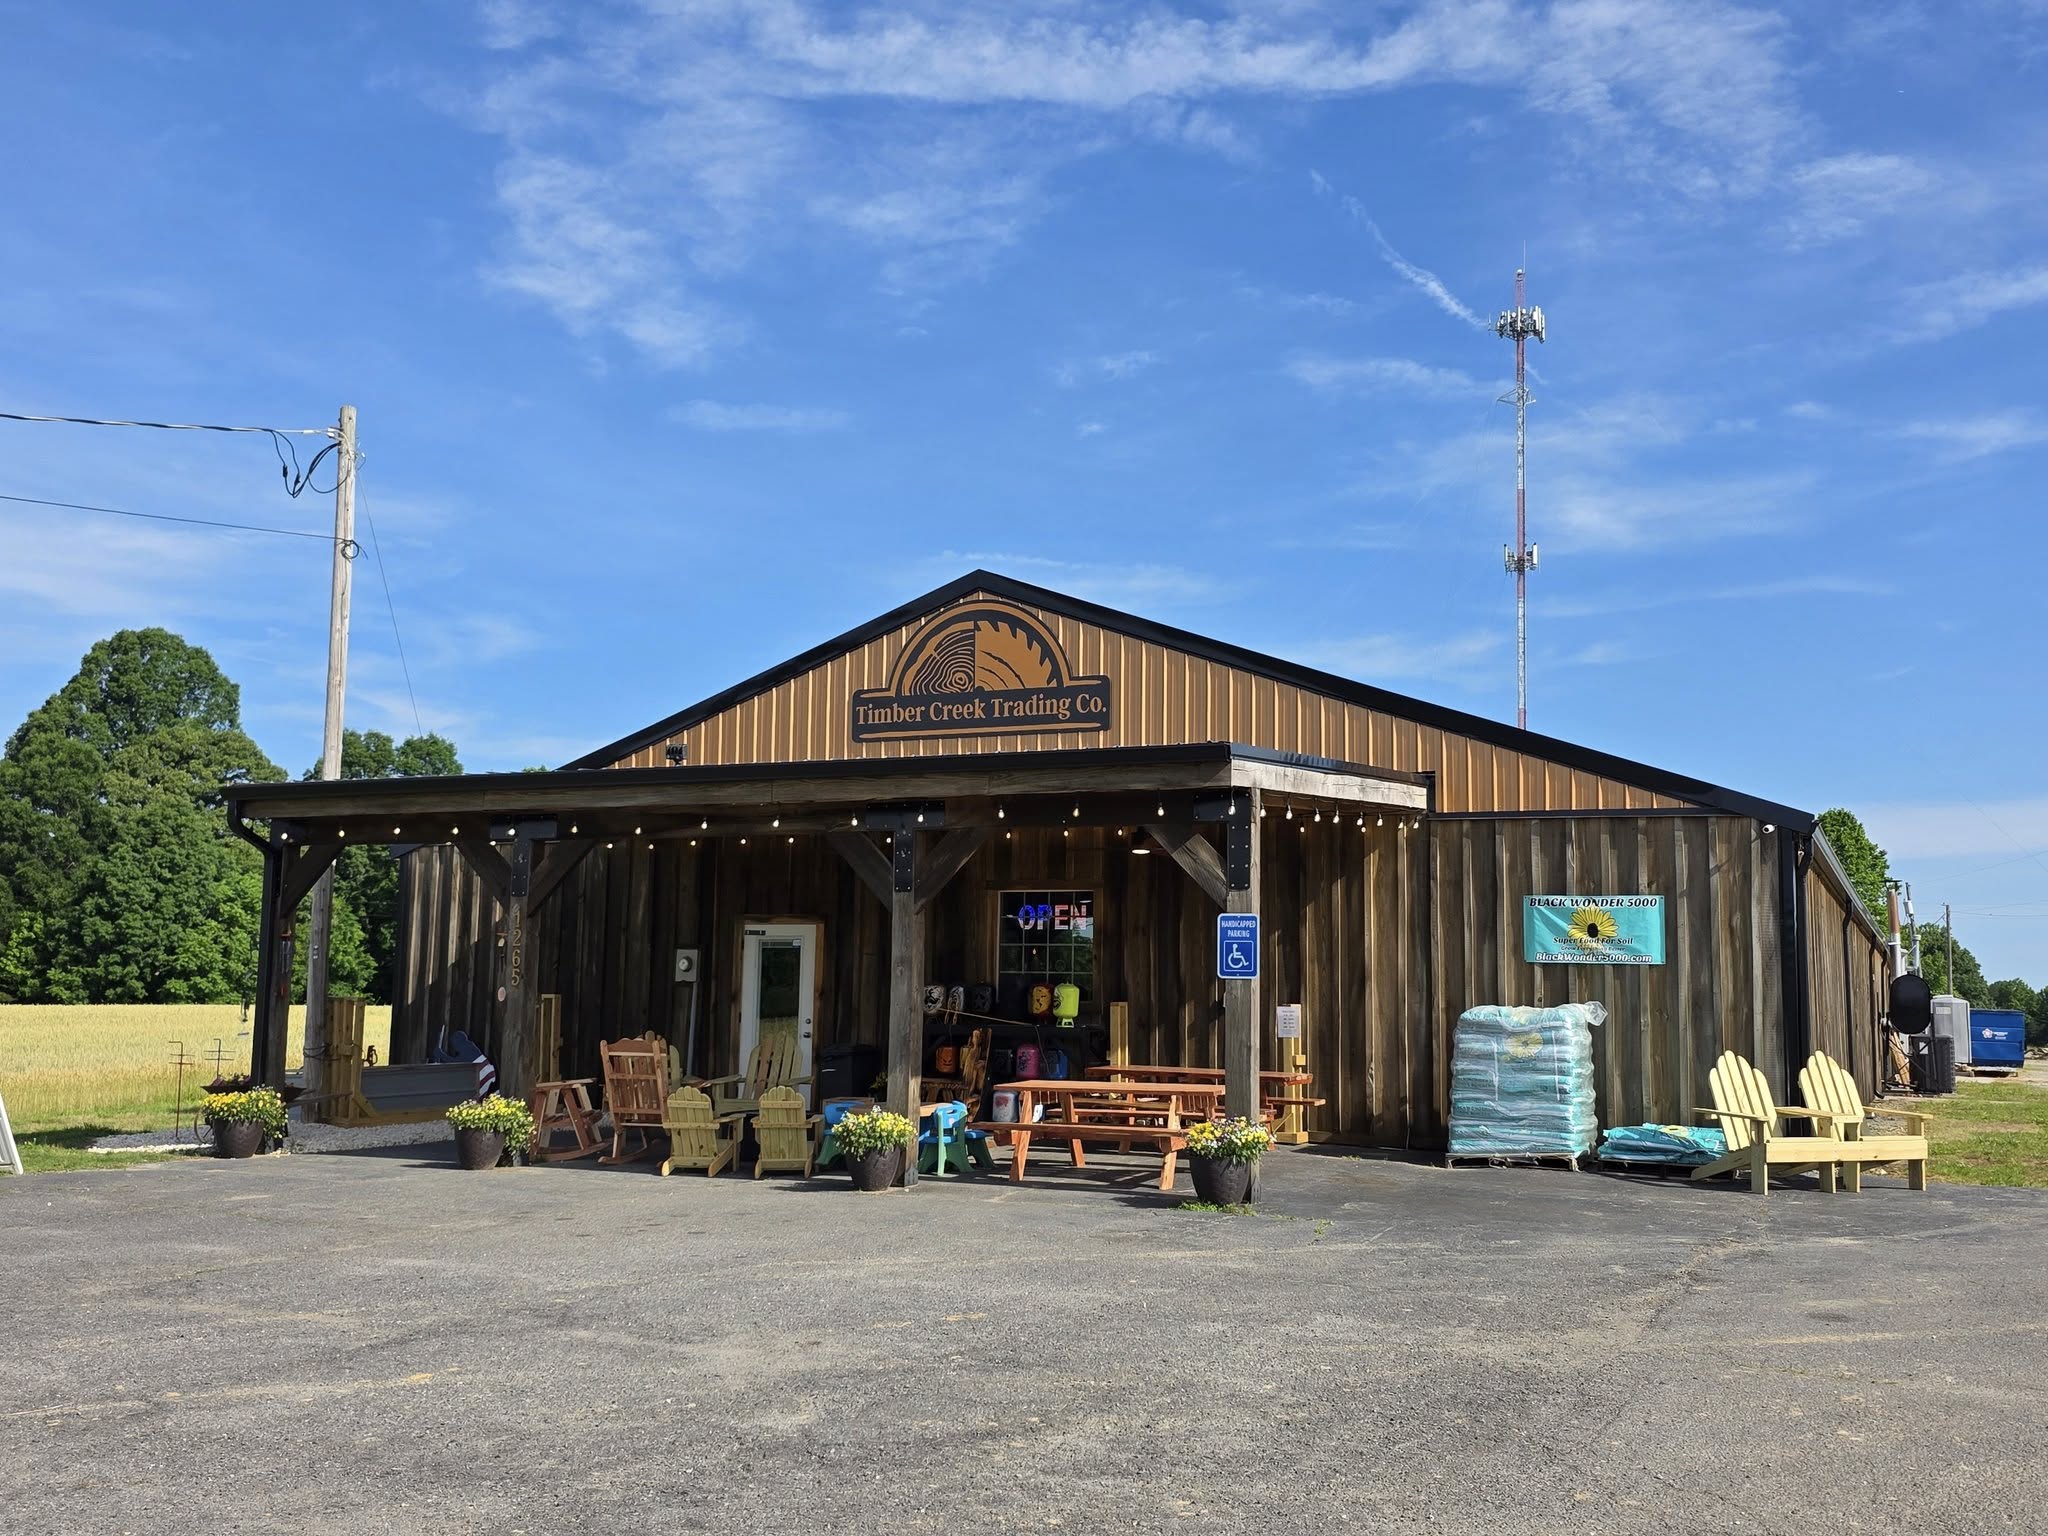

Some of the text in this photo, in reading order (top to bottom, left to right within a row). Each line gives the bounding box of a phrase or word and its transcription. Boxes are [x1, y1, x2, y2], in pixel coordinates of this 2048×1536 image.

[856, 693, 1108, 725] Timber Creek Trading Co.
[1529, 897, 1658, 907] BLACK WONDER 5000
[1017, 904, 1087, 930] OPEN
[1221, 920, 1257, 928] HANDICAPPED
[1227, 929, 1250, 938] PARKING
[1553, 936, 1577, 945] Super
[1616, 937, 1633, 945] Soil
[1536, 952, 1653, 962] BlackWonder5000.com
